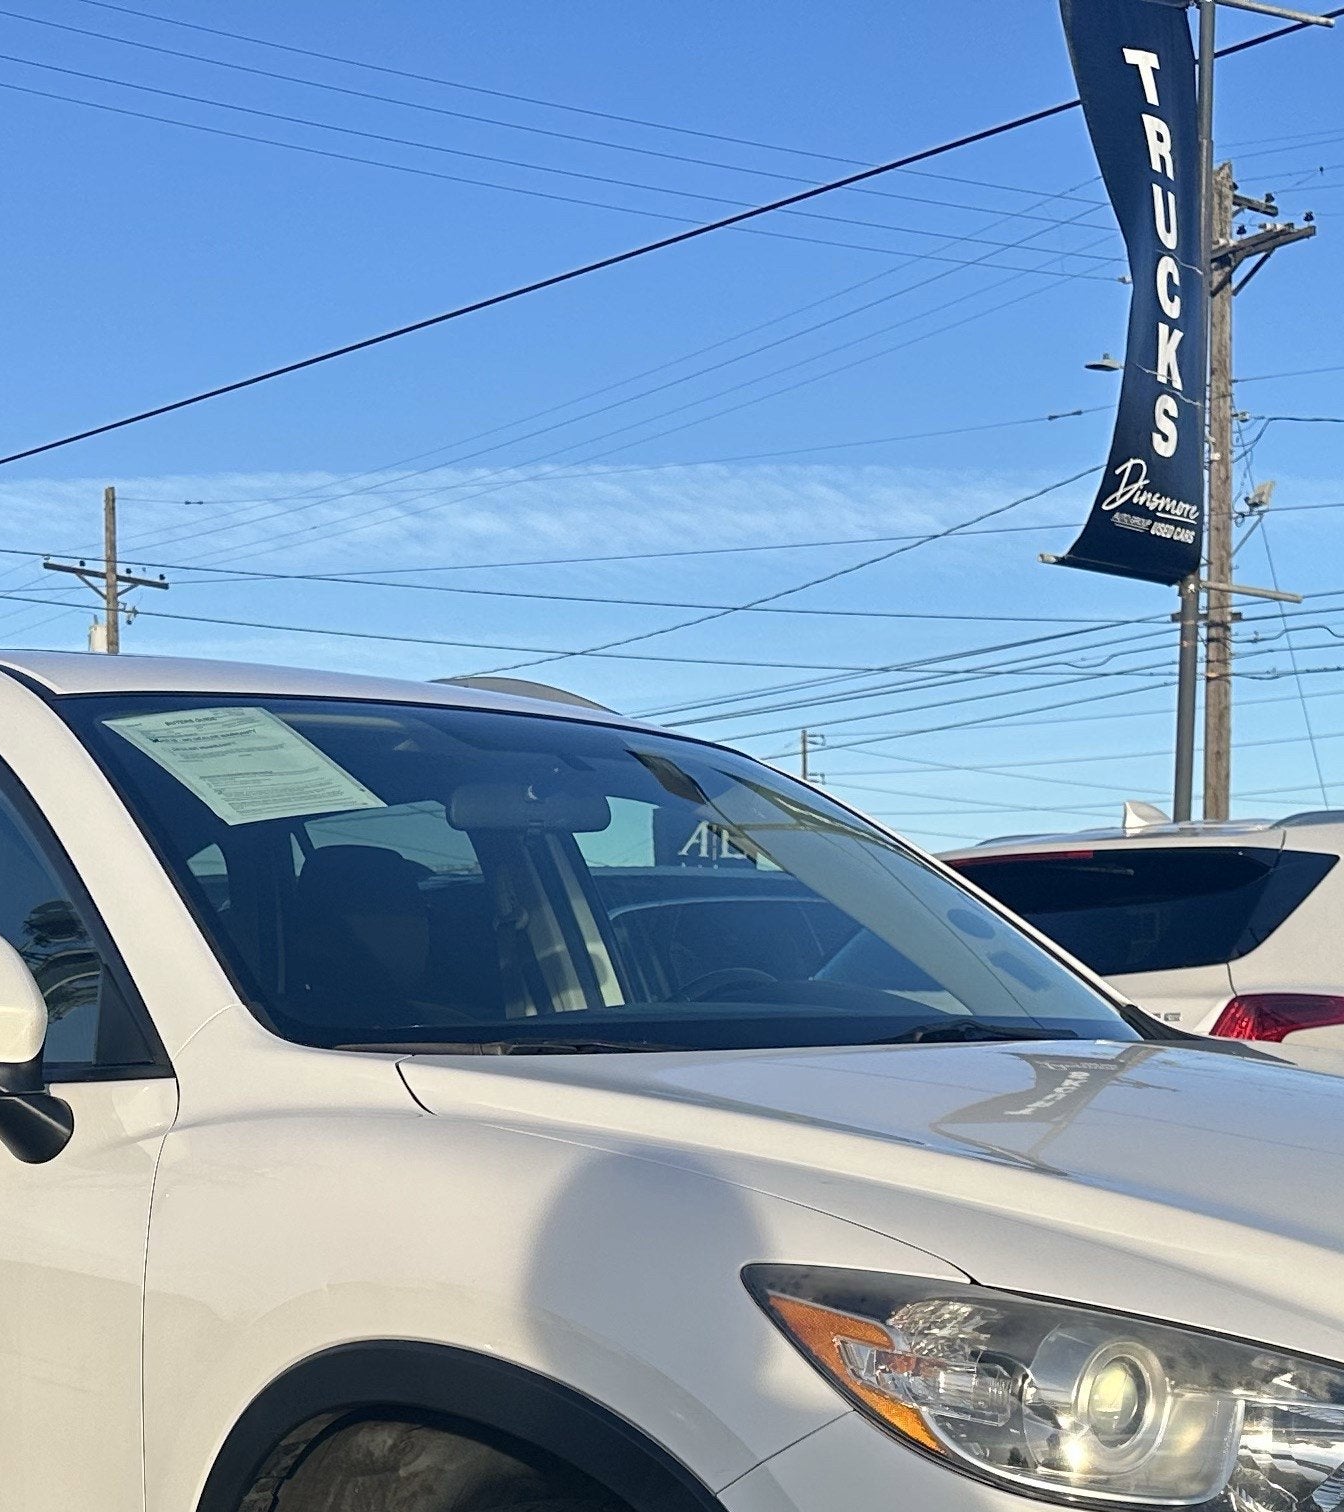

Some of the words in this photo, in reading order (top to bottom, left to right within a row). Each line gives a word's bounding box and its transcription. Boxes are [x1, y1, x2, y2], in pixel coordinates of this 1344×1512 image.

[1122, 47, 1185, 458] TRUCKS
[1101, 458, 1200, 520] Dinsmore
[1172, 527, 1196, 544] CARS
